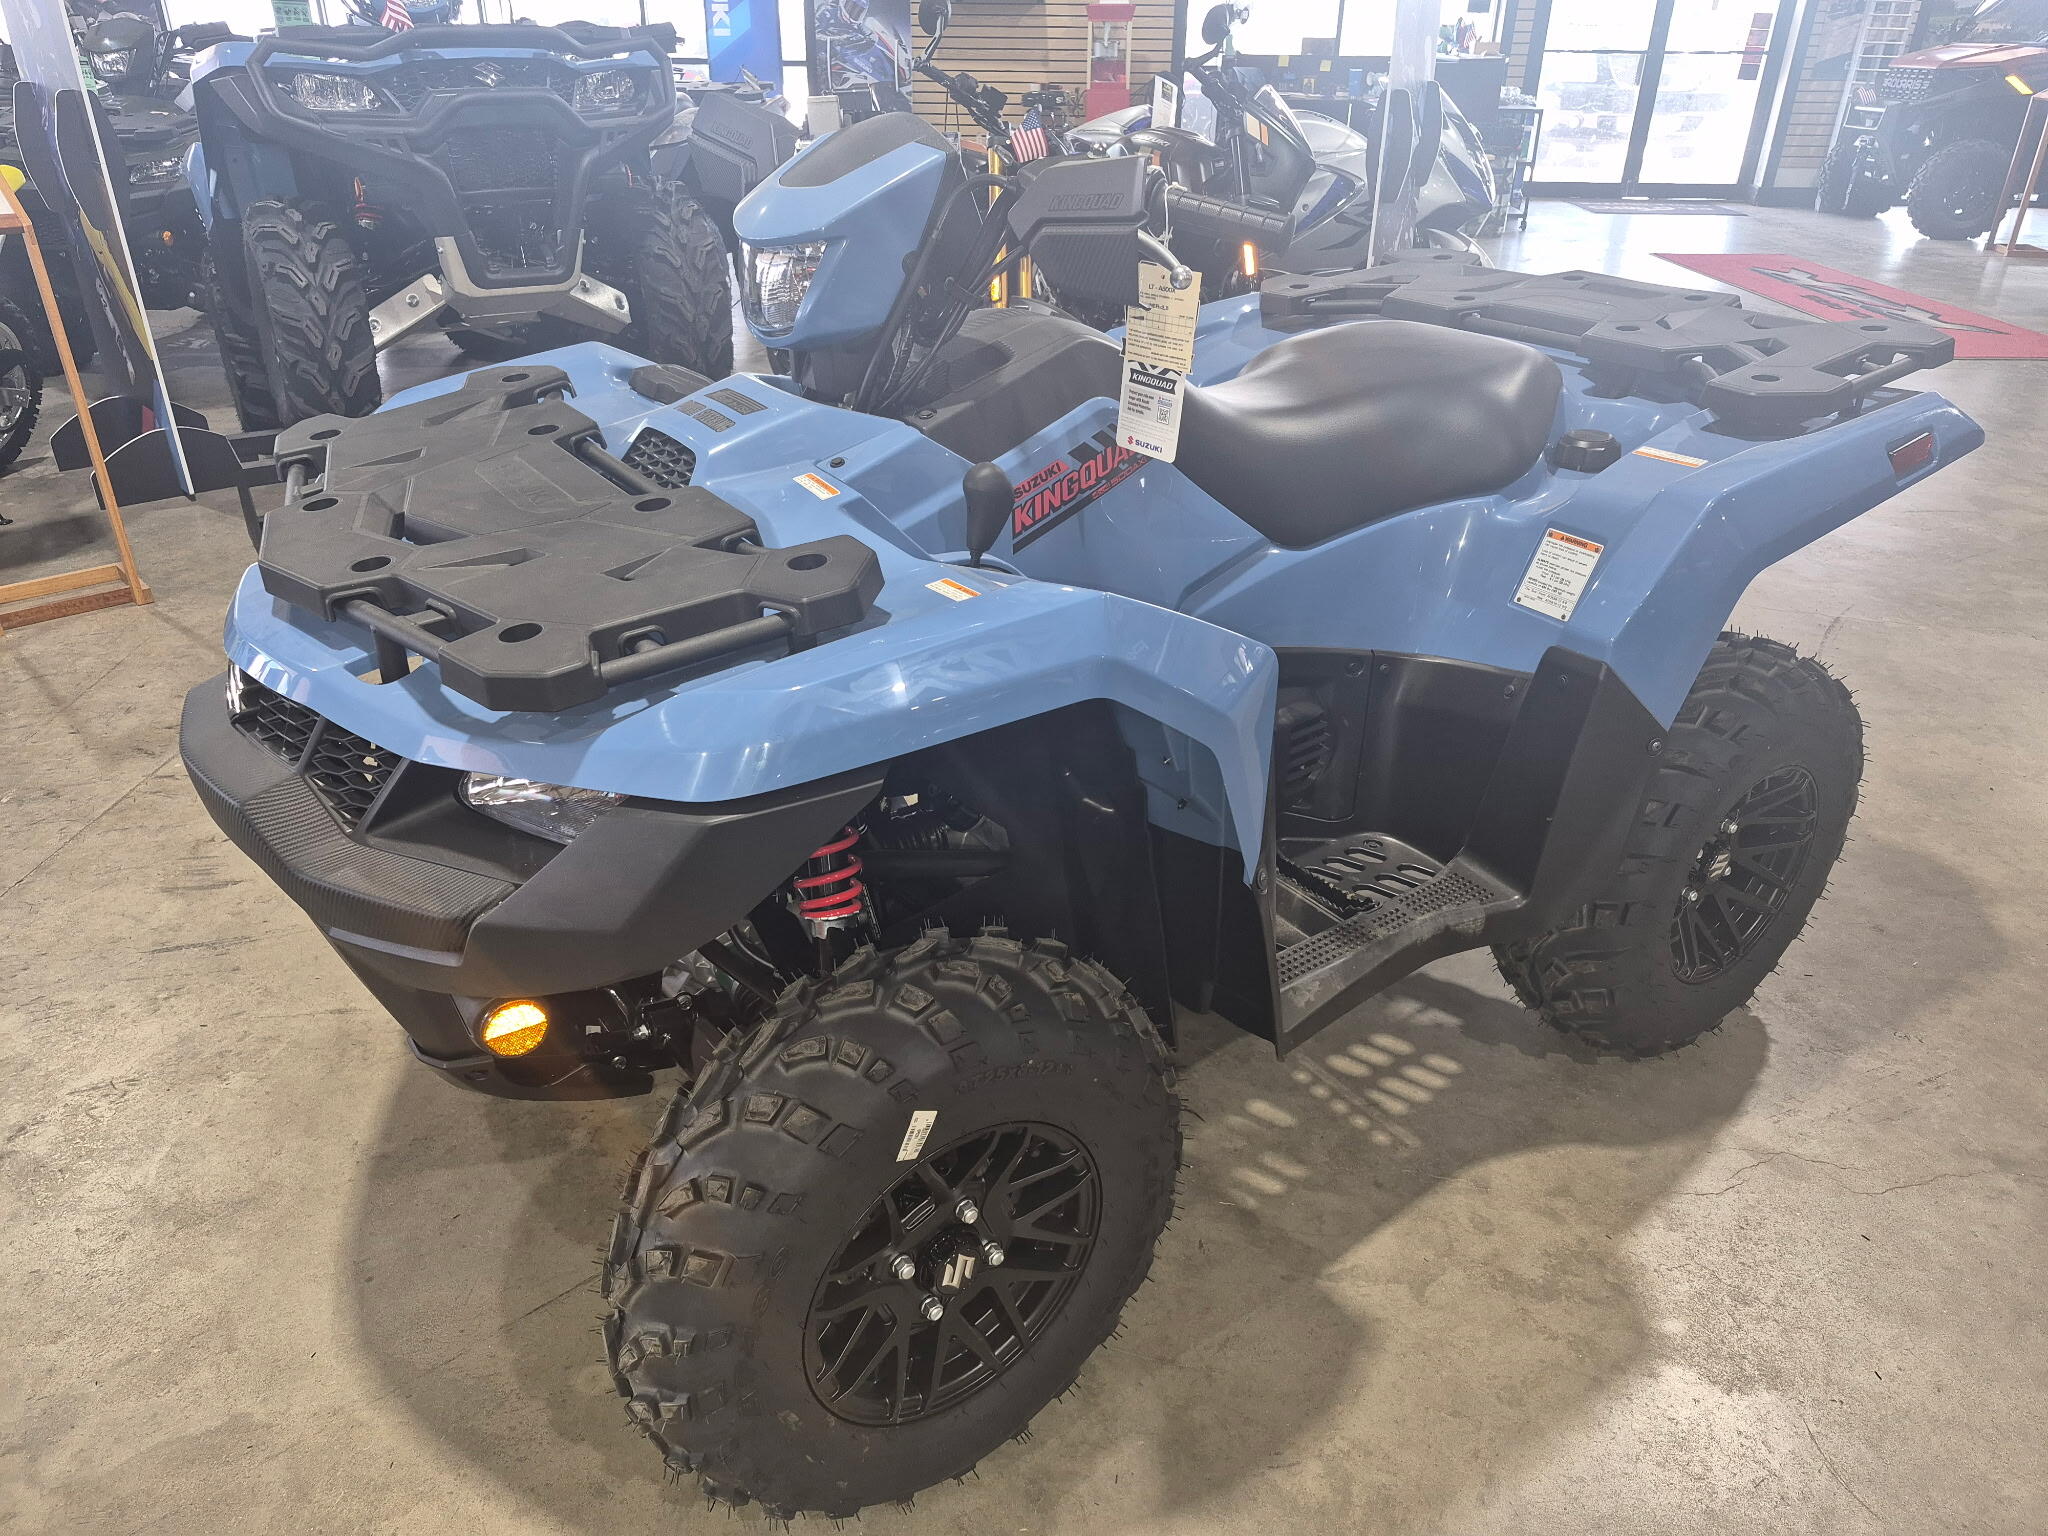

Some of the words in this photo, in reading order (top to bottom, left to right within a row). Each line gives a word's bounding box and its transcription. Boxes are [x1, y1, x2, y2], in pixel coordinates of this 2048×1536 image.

[711, 0, 731, 37] KI
[1132, 373, 1173, 390] KINGQUAD
[1135, 439, 1162, 453] SUZUKI
[1014, 461, 1063, 500] SUZUKI
[1014, 446, 1137, 534] KINGQUA
